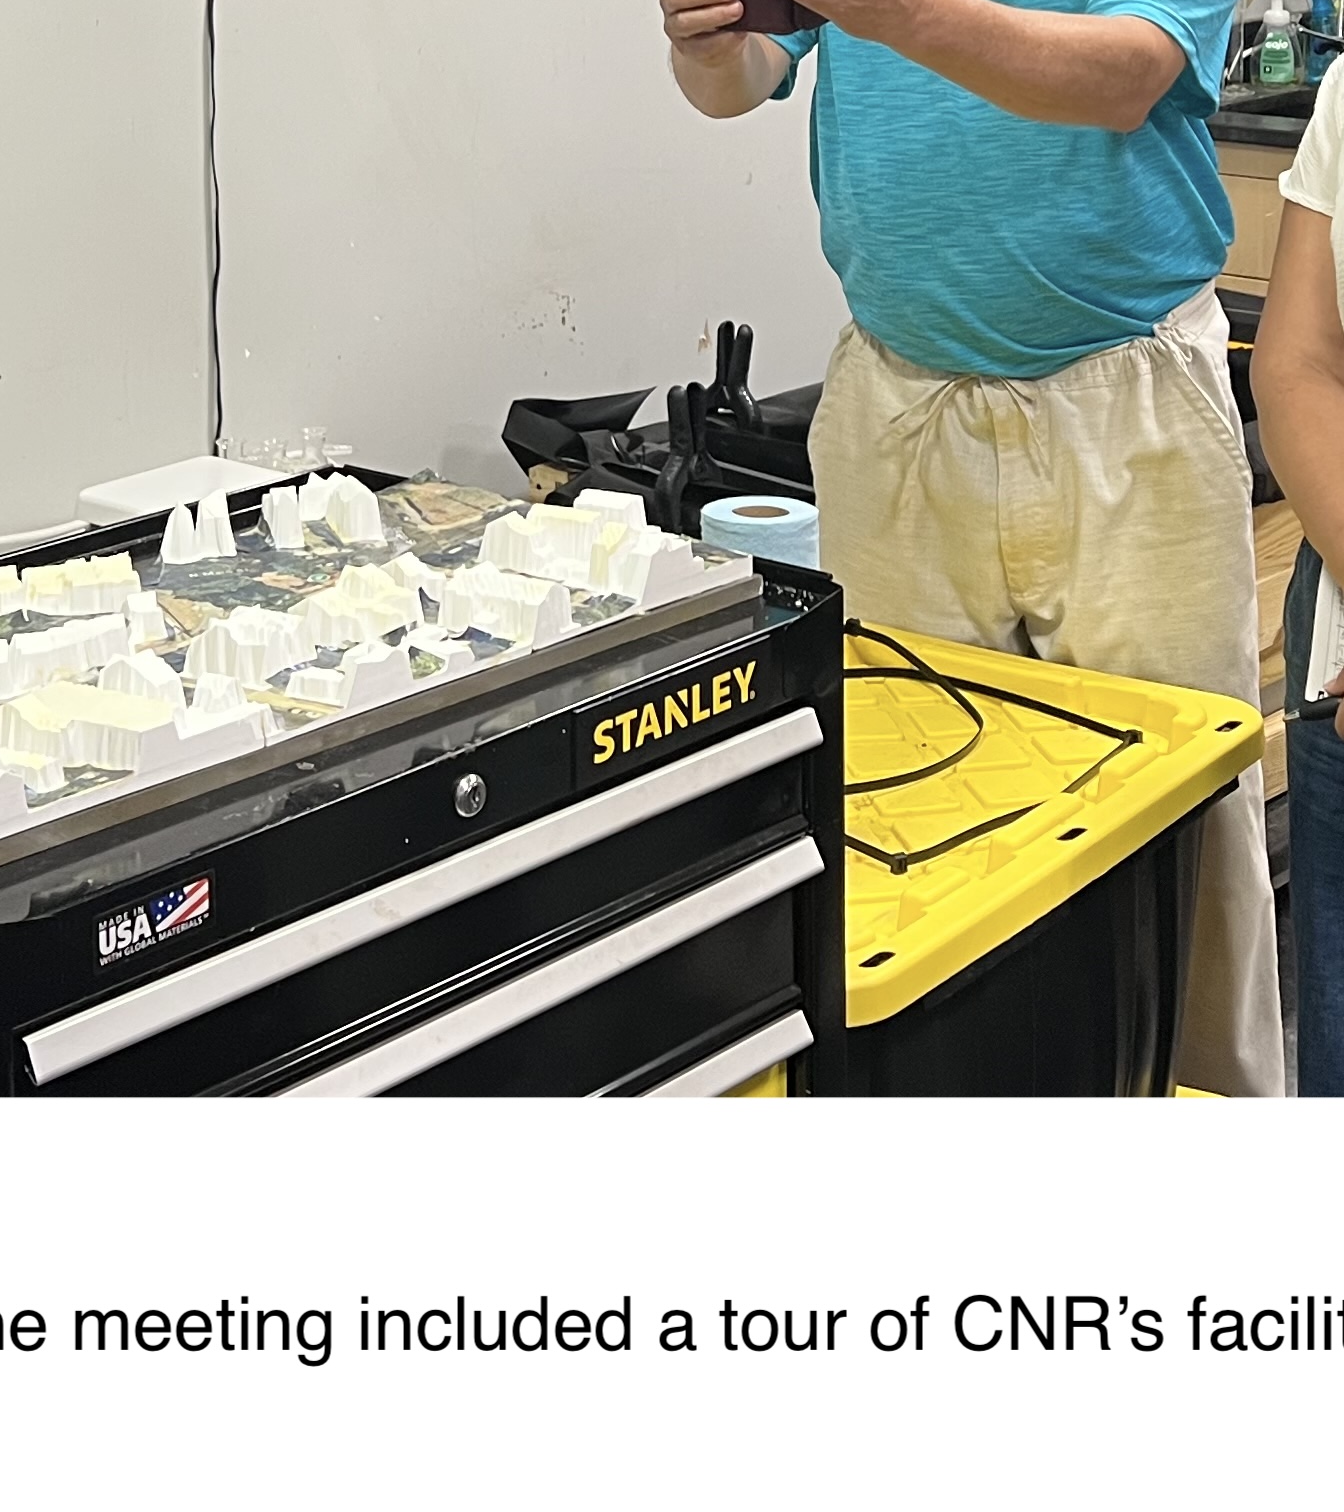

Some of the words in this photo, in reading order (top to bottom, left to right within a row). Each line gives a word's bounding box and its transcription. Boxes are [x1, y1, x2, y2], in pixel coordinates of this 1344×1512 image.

[593, 661, 756, 764] STANLEY
[98, 911, 129, 931] MADE
[133, 905, 145, 917] IN
[98, 913, 152, 956] USA
[99, 950, 123, 966] WITH
[124, 936, 157, 956] GLOBAL
